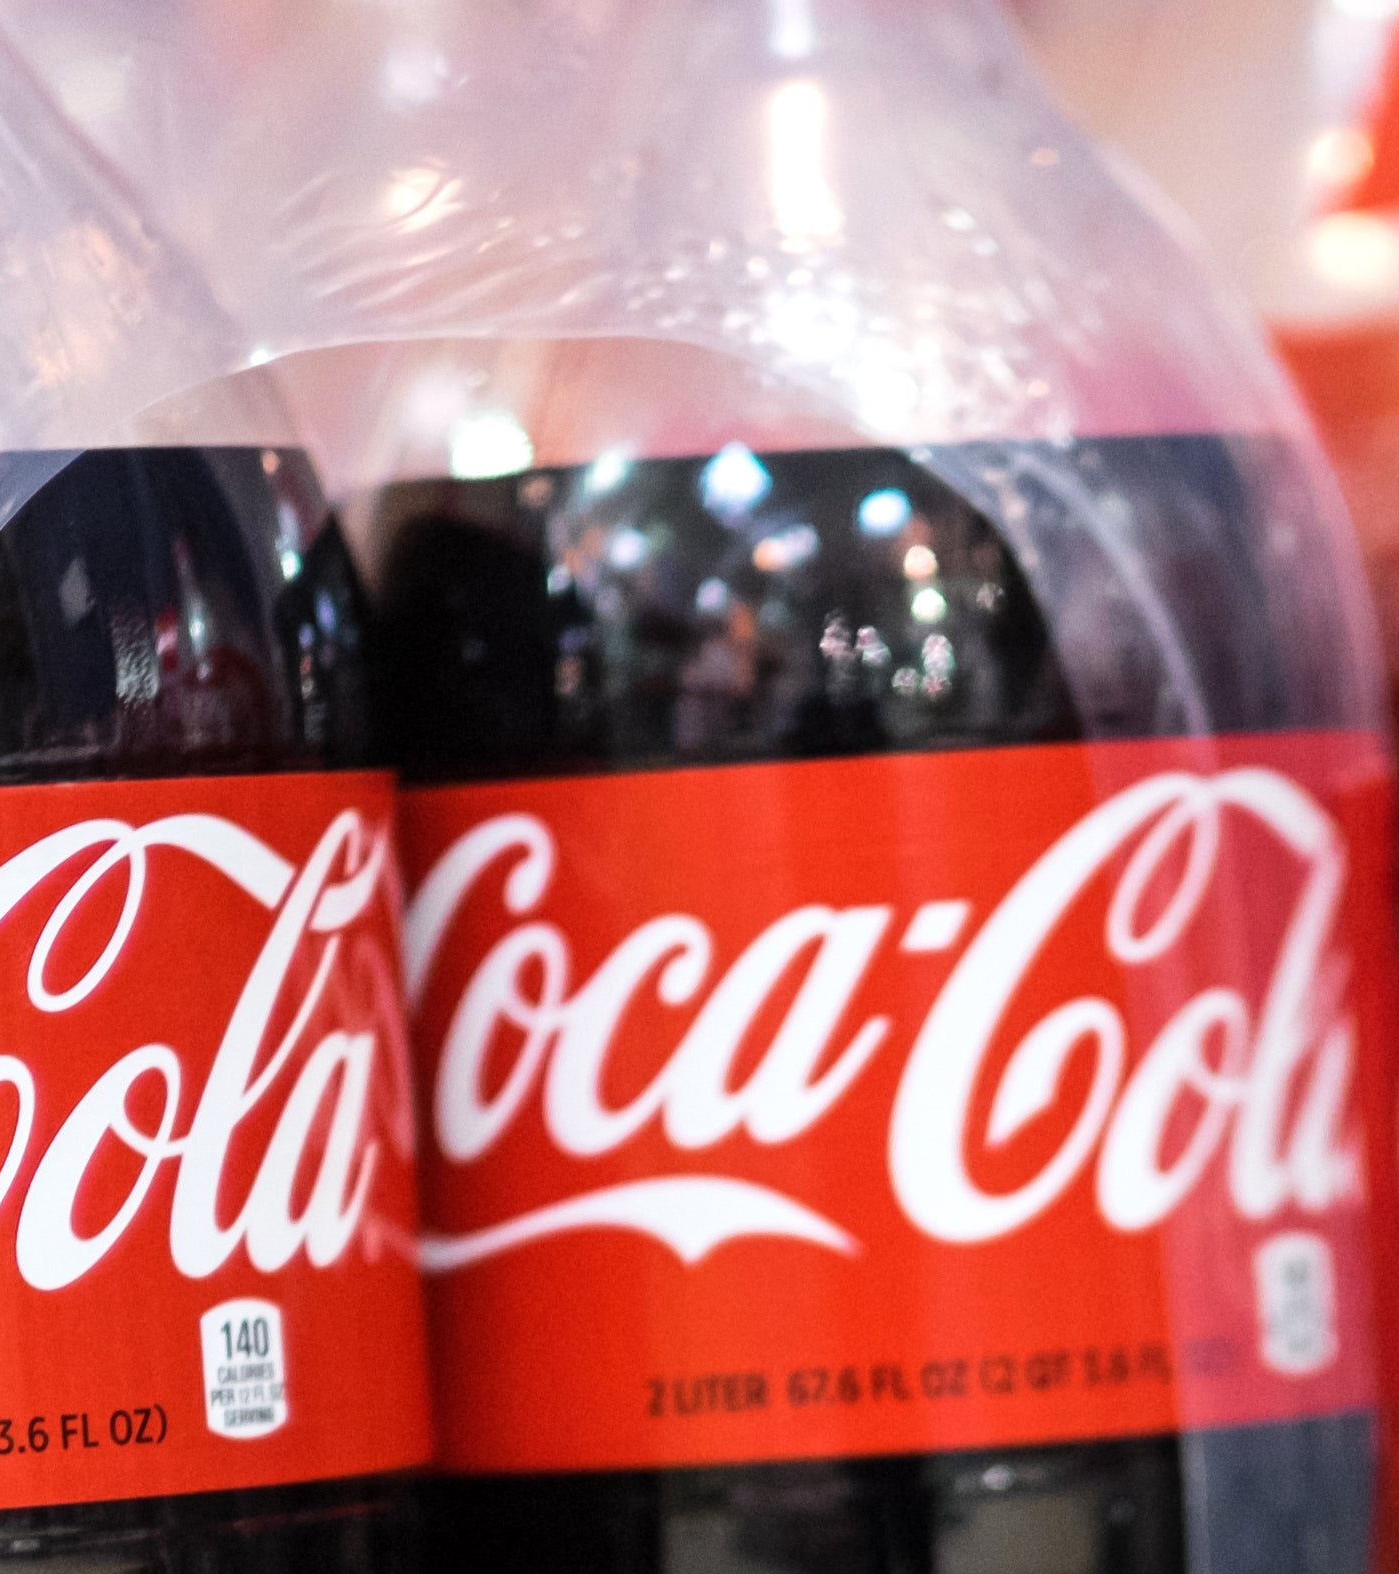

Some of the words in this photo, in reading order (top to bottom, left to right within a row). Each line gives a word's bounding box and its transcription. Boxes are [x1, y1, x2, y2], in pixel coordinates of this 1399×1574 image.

[220, 1315, 270, 1361] 140
[60, 1411, 100, 1450] FL
[109, 1402, 168, 1446] OZ)
